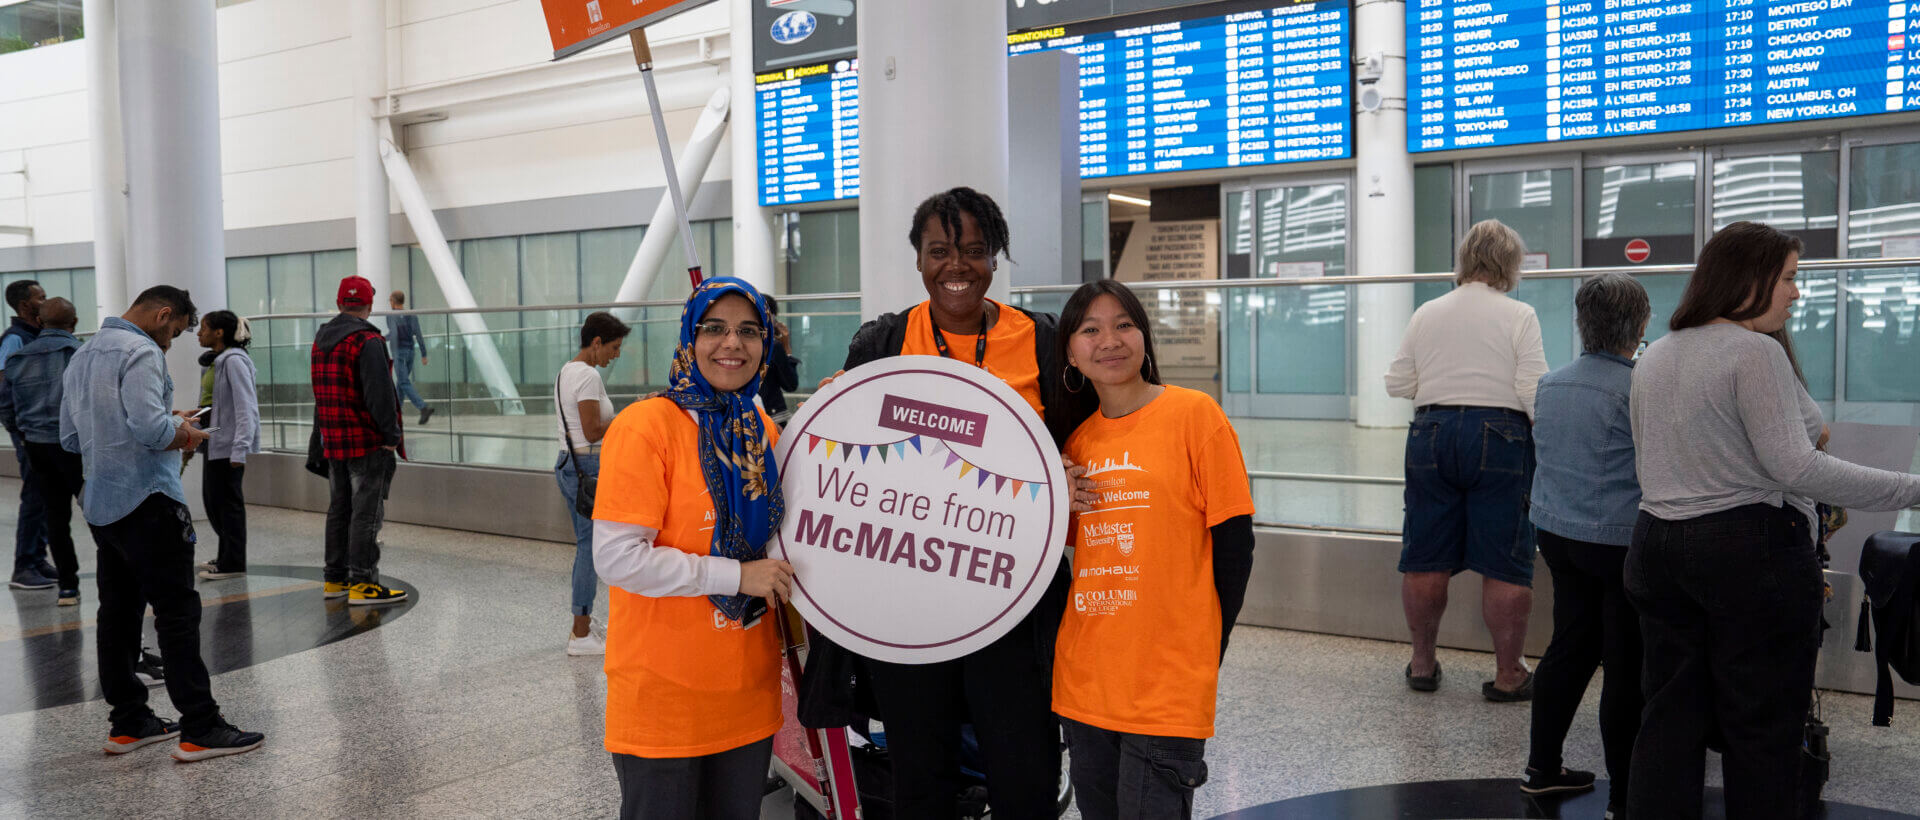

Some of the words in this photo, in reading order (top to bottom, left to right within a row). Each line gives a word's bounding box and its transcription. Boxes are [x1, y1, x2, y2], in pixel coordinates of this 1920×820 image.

[1454, 4, 1492, 16] BOGOTA
[1454, 14, 1508, 28] FRANKFURT
[1563, 3, 1591, 14] LH470
[1726, 10, 1753, 22] 17:10
[1768, 1, 1829, 16] MONTEGO
[1454, 30, 1491, 42] DENVER
[1563, 16, 1598, 28] AC1040
[1605, 14, 1619, 22] EN
[1622, 4, 1691, 20] RETARD-16:32
[1726, 25, 1752, 36] 17:14
[1768, 16, 1818, 31] DETROIT
[1454, 40, 1519, 54] CHICAGO-ORD
[1726, 40, 1752, 50] 17:19
[1768, 28, 1851, 45] CHICAGO-ORD
[1454, 56, 1492, 68] BOSTON
[1563, 44, 1592, 54] AC771
[1605, 41, 1619, 50] EN
[1622, 32, 1691, 48] RETARD-17:31
[1726, 54, 1752, 65] 17:30
[1768, 46, 1824, 60] ORLANDO
[1455, 71, 1473, 80] SAN
[1475, 65, 1528, 78] FRANCISCO
[1605, 55, 1619, 64] EN
[1621, 47, 1691, 62] RETARD-17:03
[1726, 69, 1752, 80] 17:30
[1768, 62, 1819, 75] WARSAW
[1455, 82, 1493, 93] CANCUN
[1605, 69, 1618, 78] EN
[1455, 98, 1472, 106] TEL
[1473, 95, 1493, 104] AVIV
[1605, 83, 1619, 92] EN
[1622, 75, 1691, 90] RETARD-17:05
[1725, 83, 1752, 94] 17:34
[1767, 78, 1808, 89] AUSTIN
[1725, 98, 1751, 108] 17:34
[1838, 88, 1855, 97] OH
[1455, 107, 1504, 119] NASHVILLE
[1455, 120, 1508, 132] TOKYO-HND
[1605, 110, 1619, 119] EN
[1725, 112, 1751, 123] 17:35
[1767, 108, 1794, 119] NEW
[1796, 103, 1856, 116] YORK-LGA
[1455, 134, 1494, 145] NEWARK
[892, 405, 976, 437] WELCOME
[817, 463, 869, 508] We
[878, 488, 931, 521] are
[943, 493, 1016, 540] from
[1103, 489, 1150, 503] Welcome
[1083, 522, 1134, 538] McMaster
[794, 508, 1016, 590] McMASTER
[1086, 589, 1138, 601] COLUMBIA
